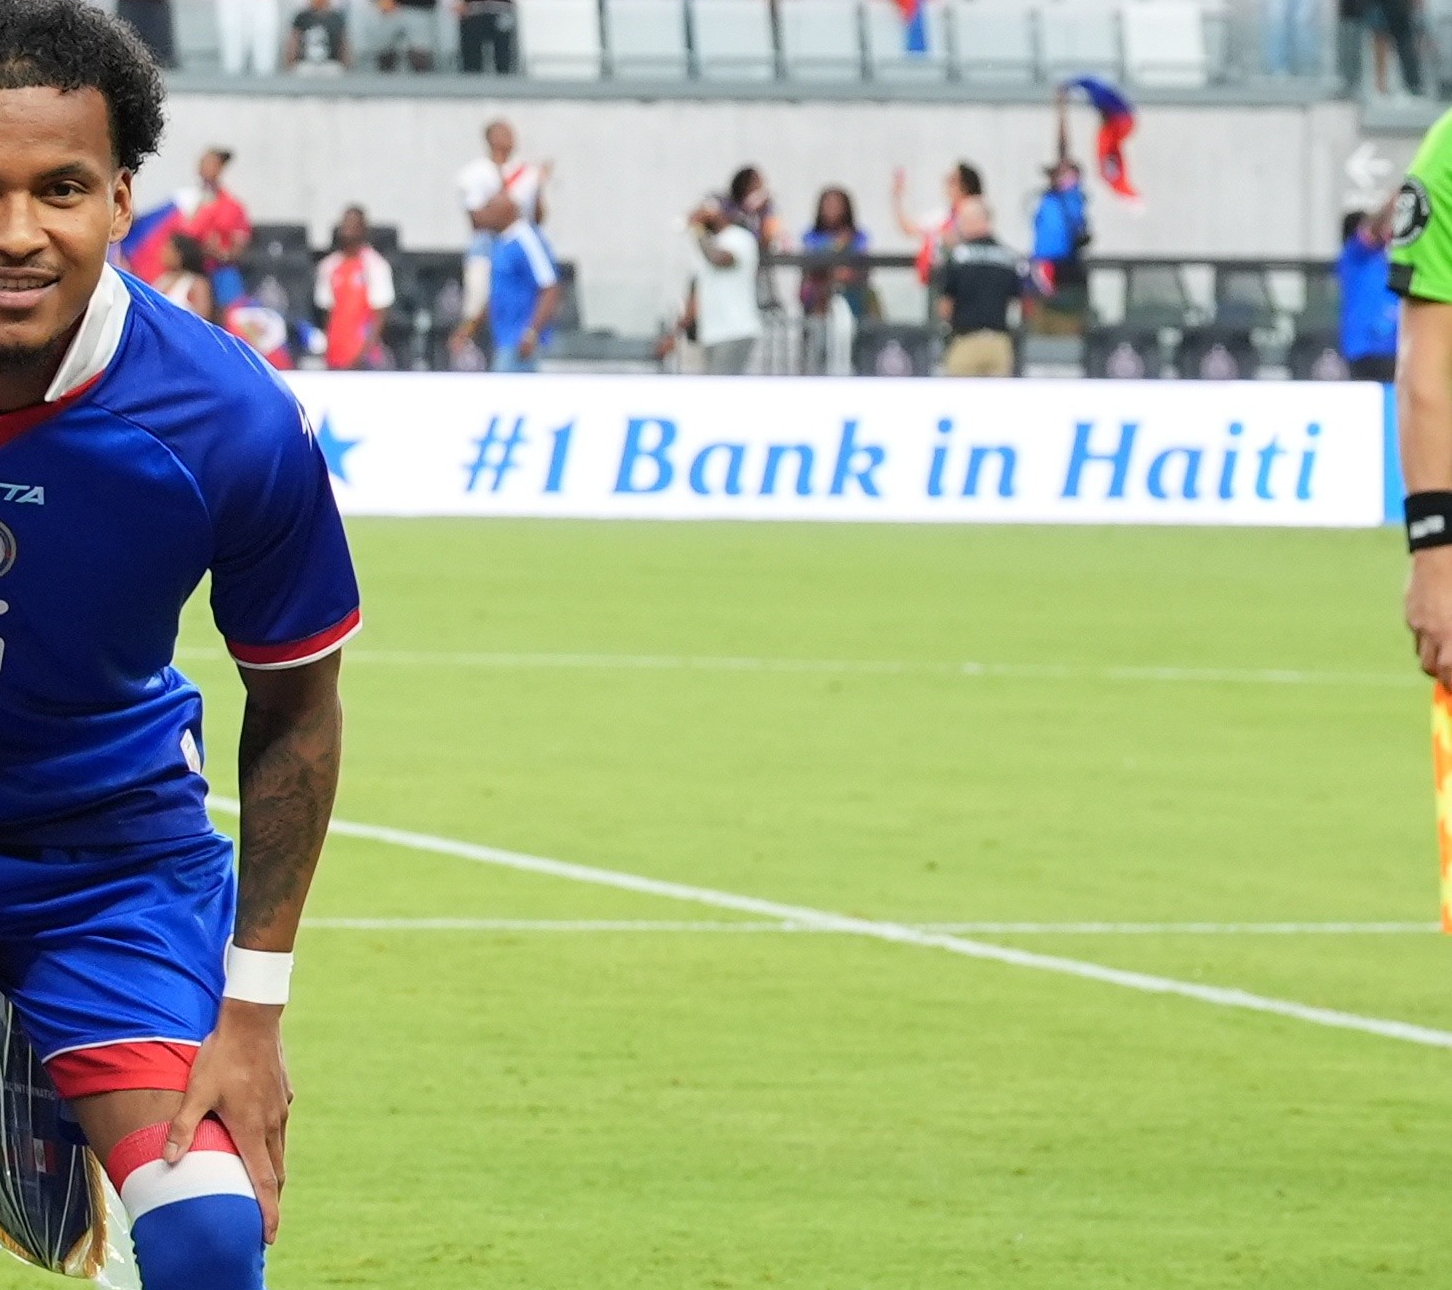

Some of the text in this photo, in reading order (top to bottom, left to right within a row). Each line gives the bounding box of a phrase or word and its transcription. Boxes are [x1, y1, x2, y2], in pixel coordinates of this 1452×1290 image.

[465, 414, 1321, 500] #1 Bank in Haiti
